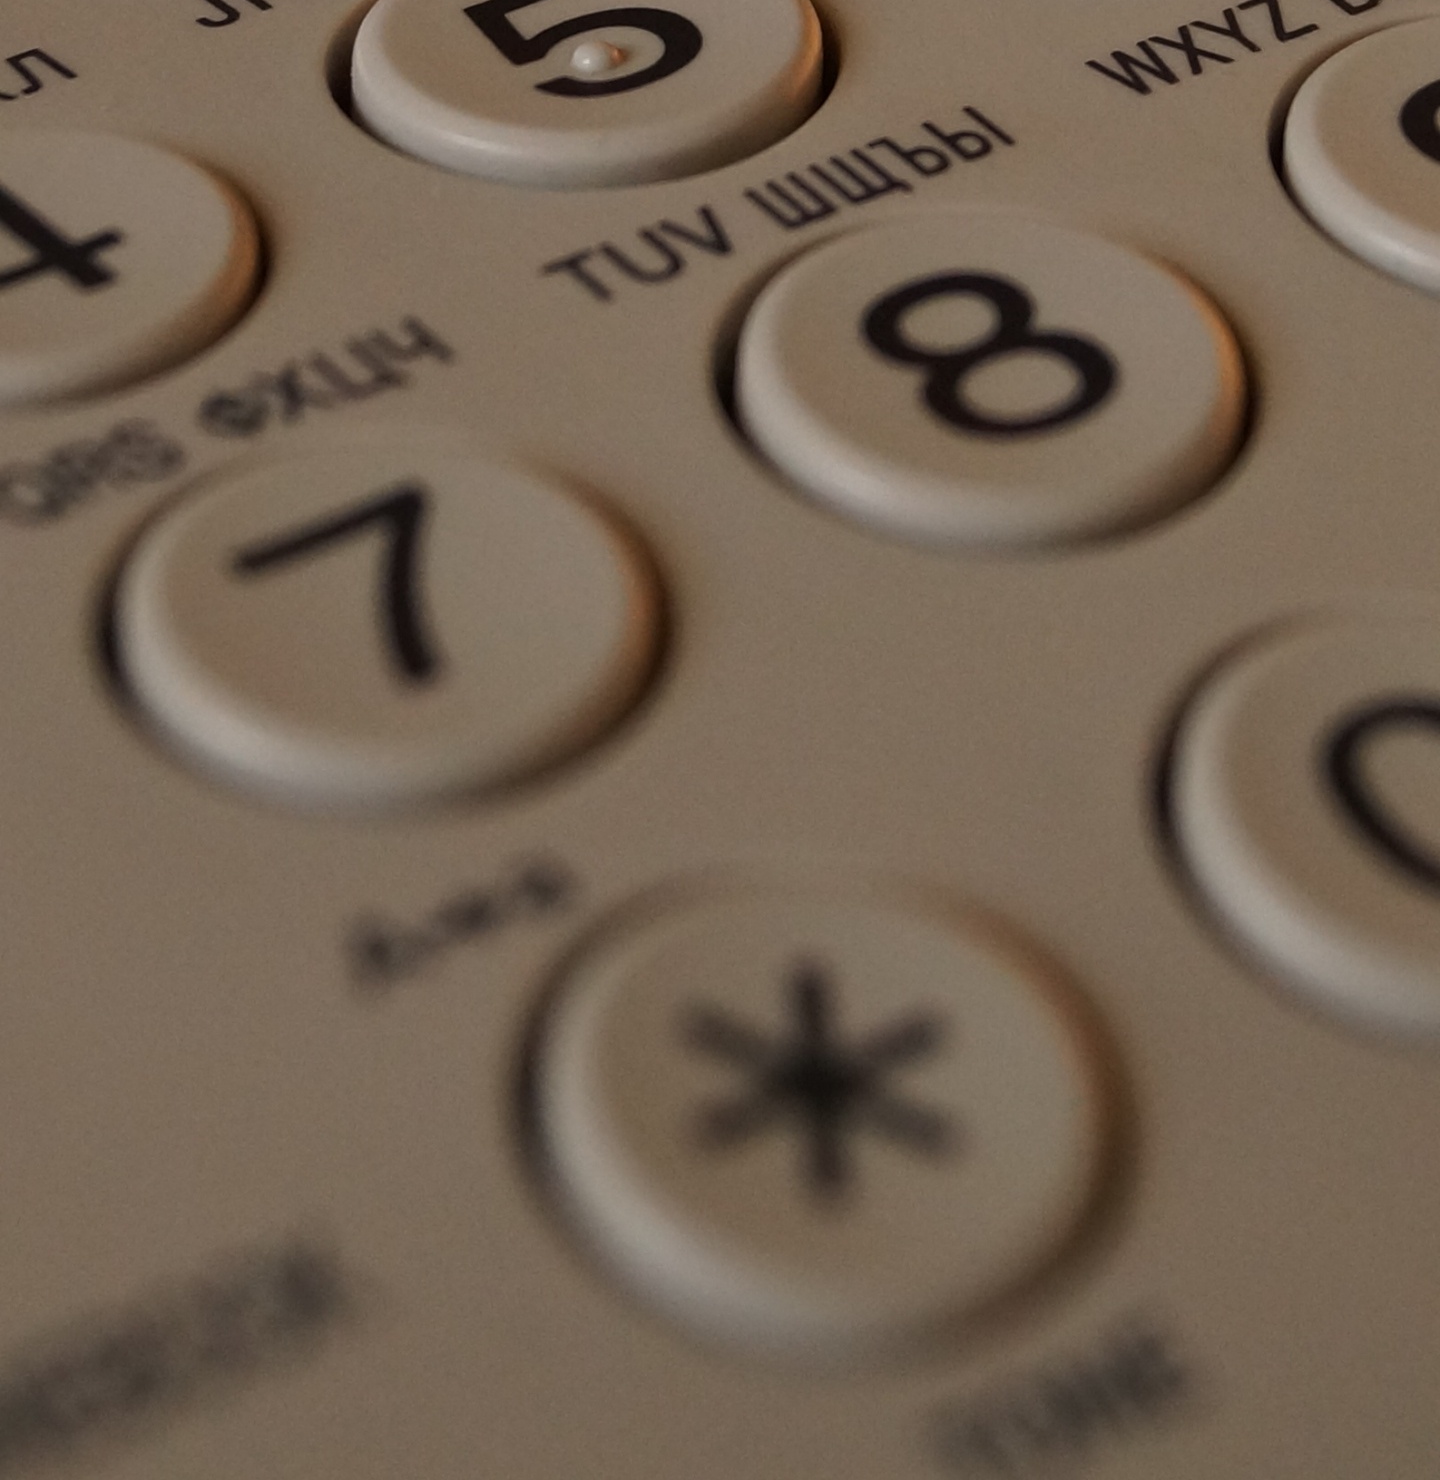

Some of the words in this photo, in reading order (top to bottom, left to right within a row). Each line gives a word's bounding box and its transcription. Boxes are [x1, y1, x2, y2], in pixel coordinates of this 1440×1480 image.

[541, 205, 733, 304] TUV
[743, 105, 1016, 230] ШЩЪЫ
[860, 268, 1118, 440] 8
[230, 482, 440, 685] 7
